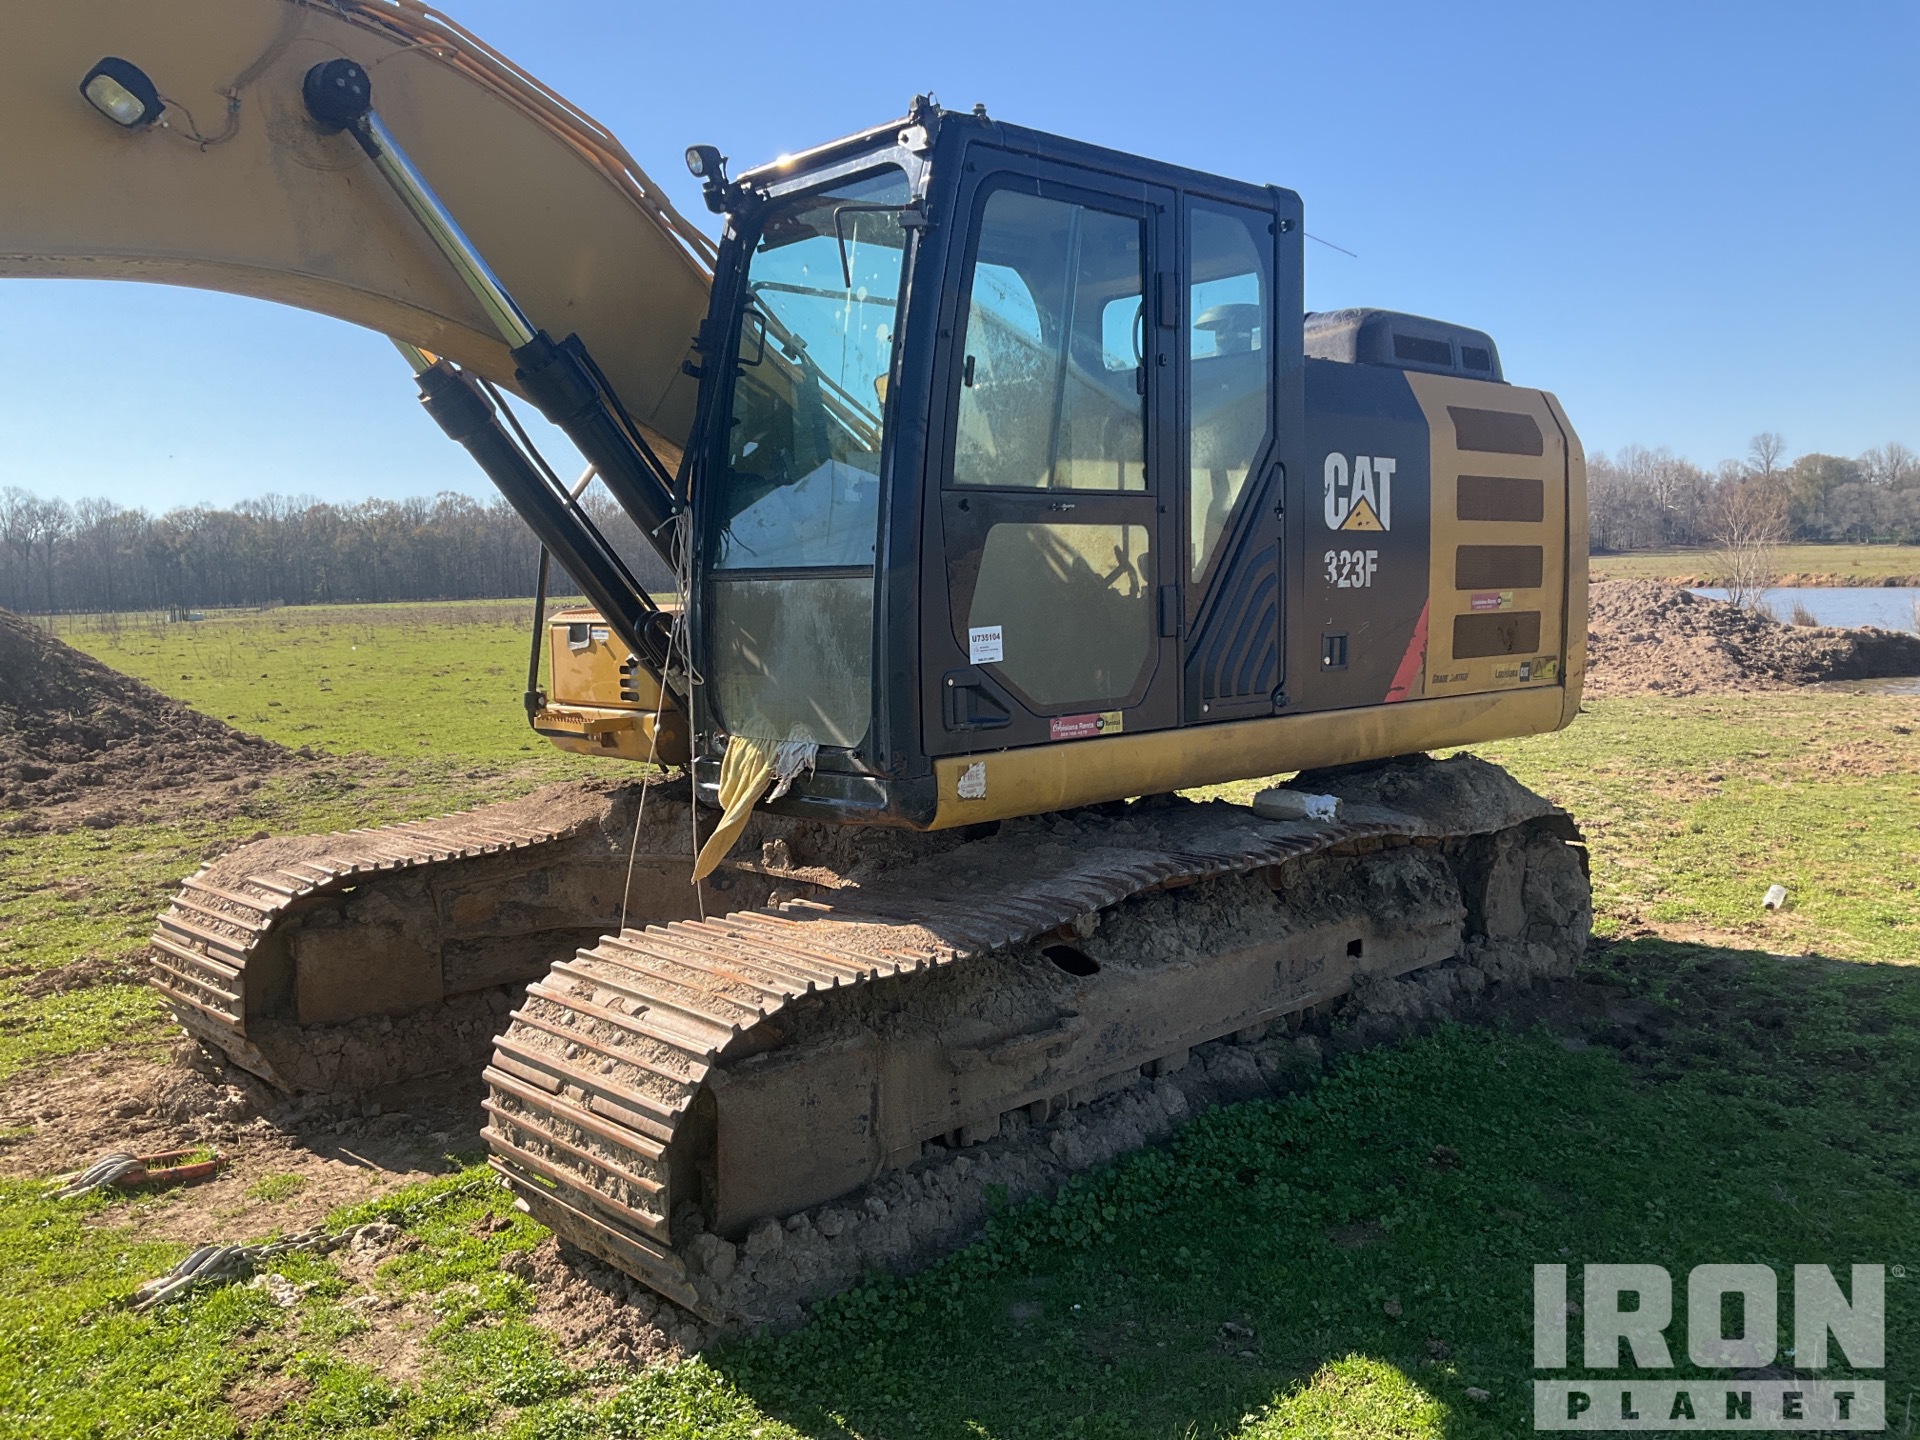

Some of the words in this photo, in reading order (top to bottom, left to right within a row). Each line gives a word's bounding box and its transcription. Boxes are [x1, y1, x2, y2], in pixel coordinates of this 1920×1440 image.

[1324, 452, 1396, 531] CAT
[1324, 550, 1378, 588] 323F
[972, 632, 1000, 642] U735104
